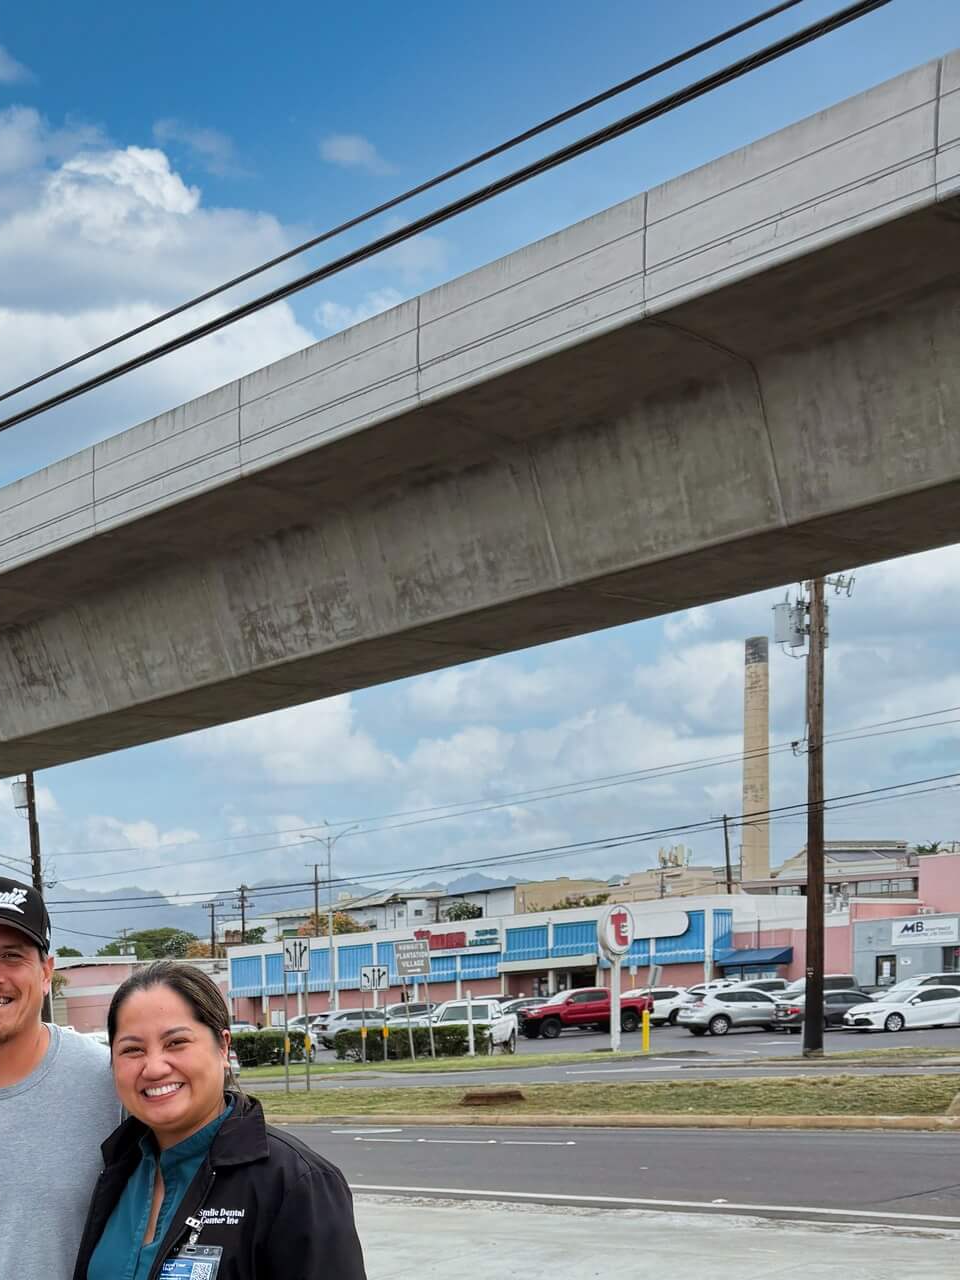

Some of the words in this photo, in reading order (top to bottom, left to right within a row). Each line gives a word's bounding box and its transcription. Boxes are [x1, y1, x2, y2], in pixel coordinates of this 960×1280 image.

[397, 951, 428, 960] PLANTATION
[400, 959, 425, 968] VILLAGE
[198, 1208, 219, 1217] Smile
[219, 1208, 245, 1217] Dental
[200, 1216, 226, 1225] Center
